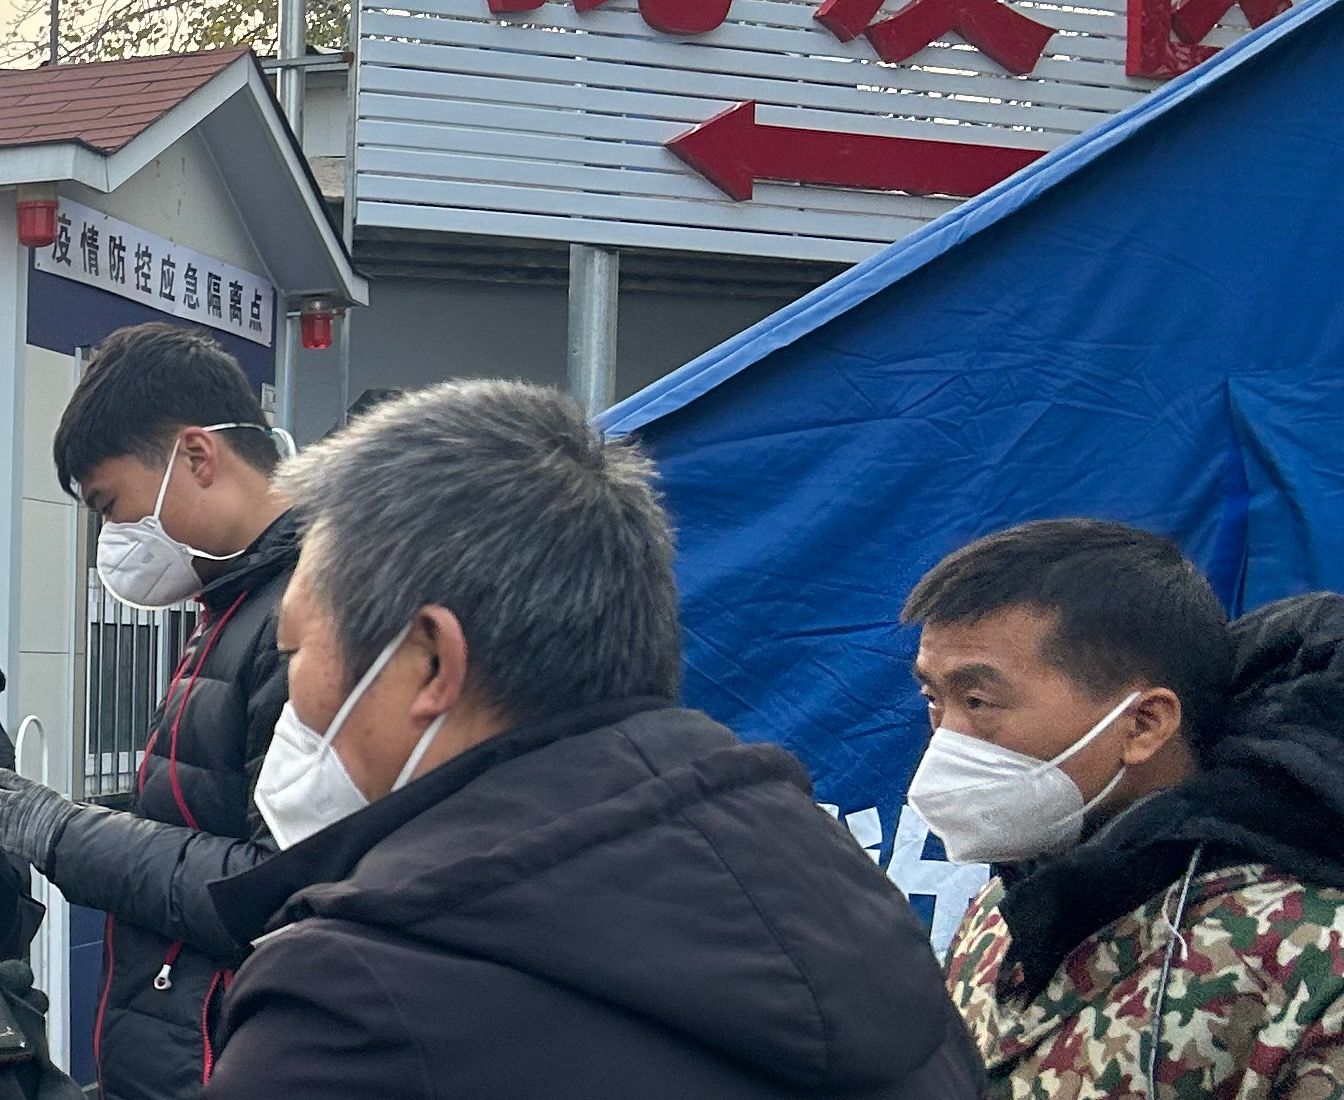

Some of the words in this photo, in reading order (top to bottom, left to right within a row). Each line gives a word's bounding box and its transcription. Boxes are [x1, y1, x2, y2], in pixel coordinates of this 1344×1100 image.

[51, 213, 263, 333] 疫情防控应急隔离点
